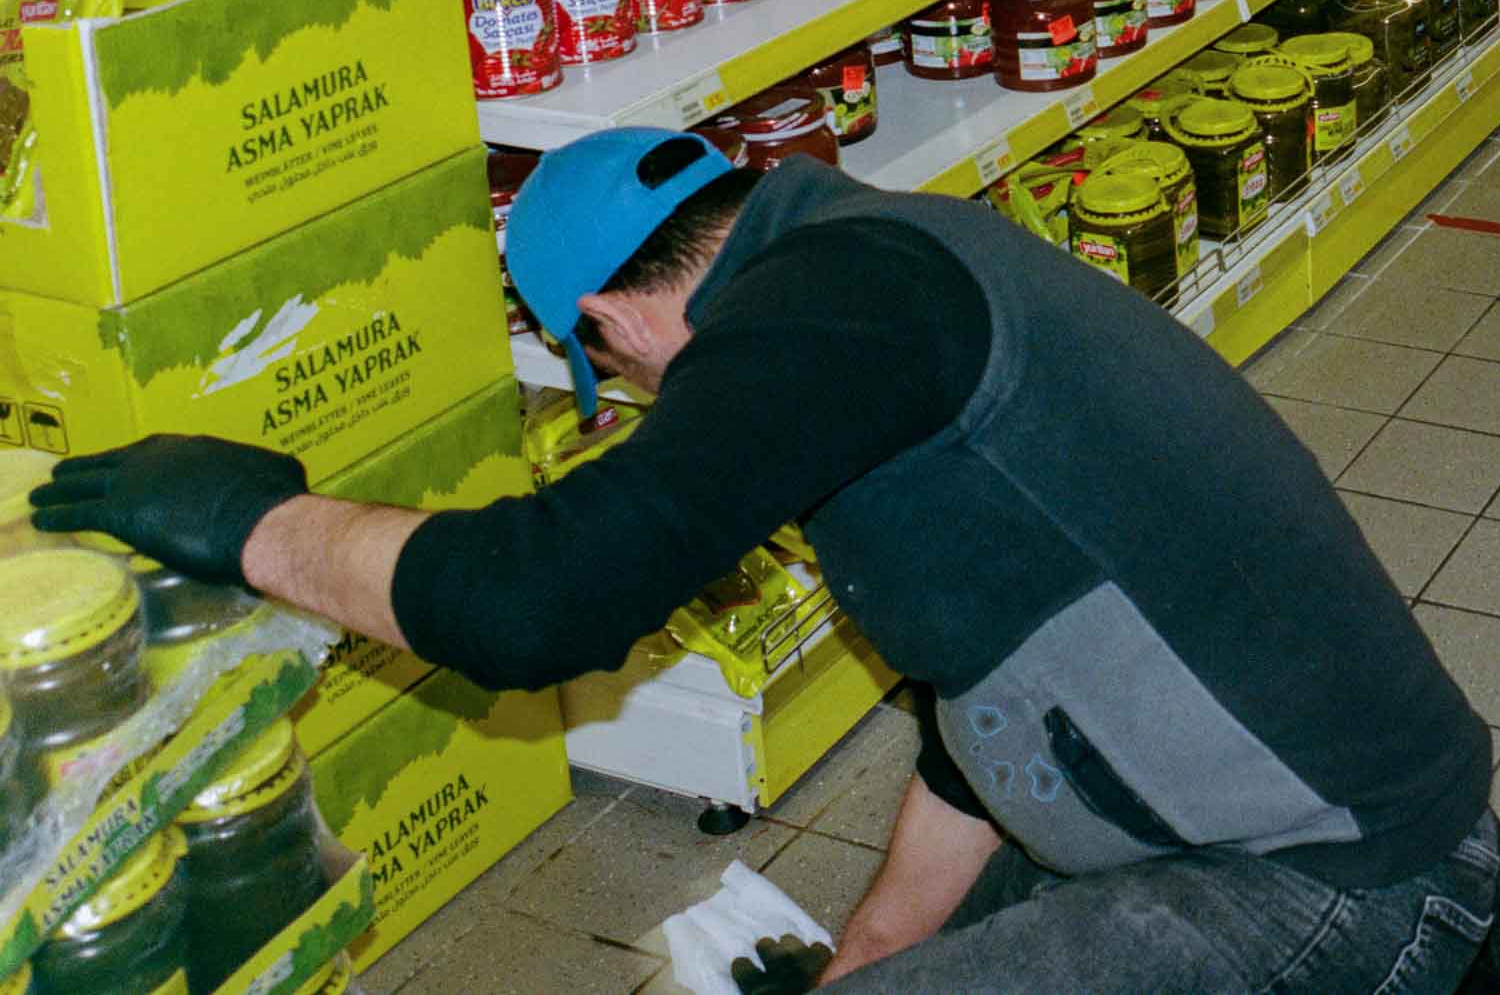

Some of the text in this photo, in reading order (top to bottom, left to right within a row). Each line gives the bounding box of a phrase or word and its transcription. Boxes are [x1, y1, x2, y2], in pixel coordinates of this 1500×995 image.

[226, 124, 294, 175] ASMA
[301, 82, 390, 140] YAPRAK
[242, 60, 368, 131] SALAMURA
[262, 383, 328, 436] ASMA
[334, 330, 422, 394] YAPRAK
[275, 312, 401, 393] SALAMURA
[371, 773, 470, 863] ALAMURA
[371, 855, 403, 891] MA
[408, 782, 489, 859] YAPRAK
